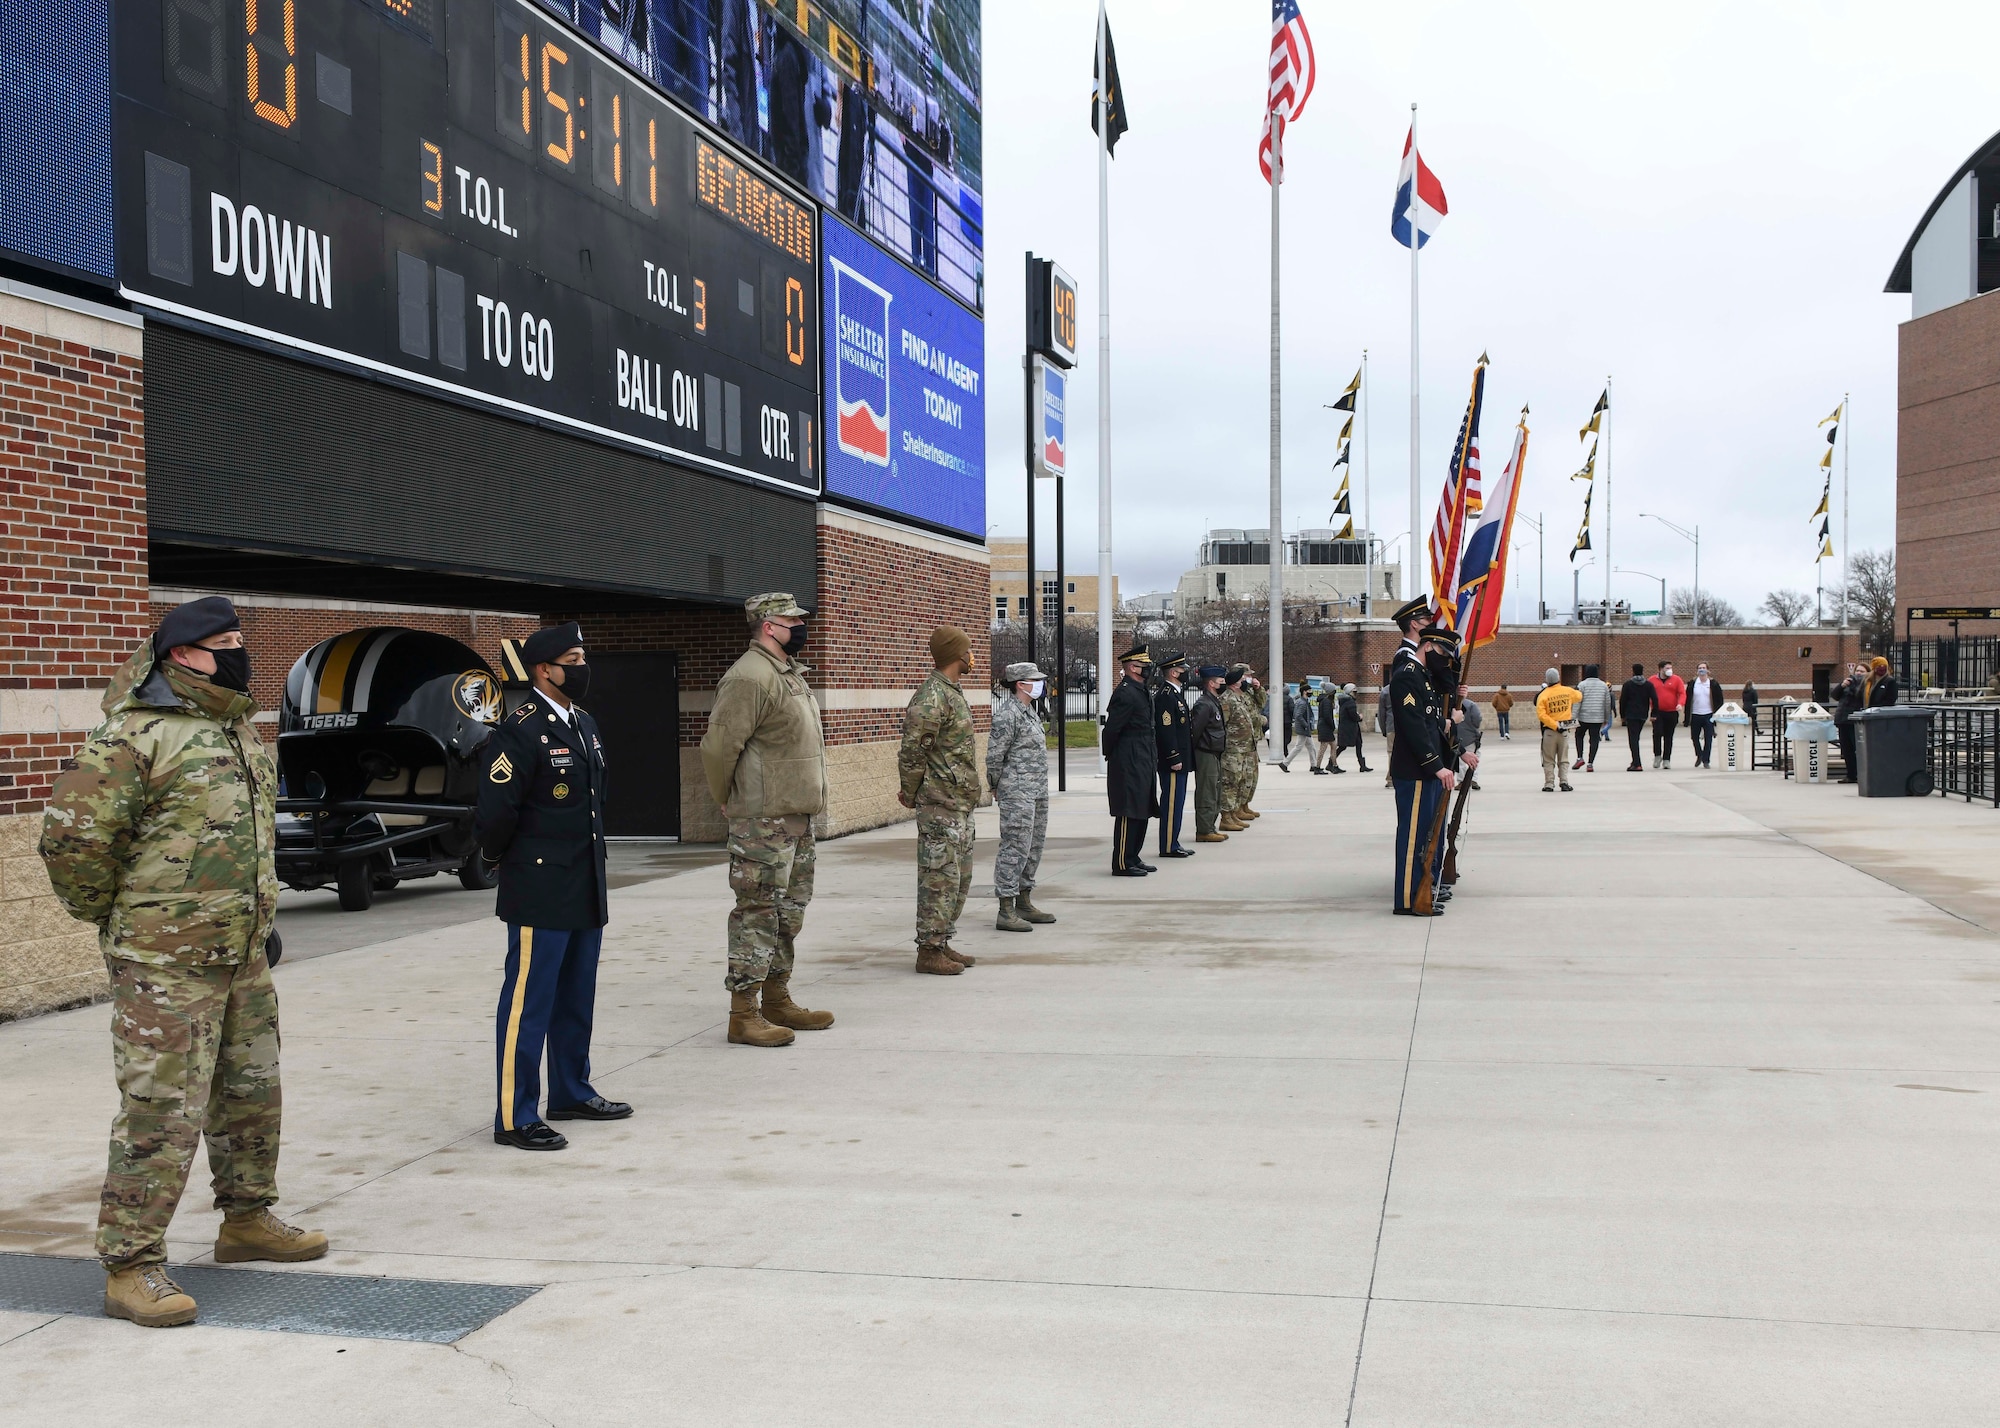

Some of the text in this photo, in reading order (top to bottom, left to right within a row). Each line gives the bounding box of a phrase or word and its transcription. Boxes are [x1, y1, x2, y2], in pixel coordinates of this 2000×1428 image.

[520, 33, 657, 208] 15:11
[423, 141, 442, 212] 3
[455, 165, 518, 239] T.O.L.
[698, 143, 811, 264] GEORGIA
[211, 191, 333, 310] DOWN
[643, 259, 687, 316] T.O.L.
[694, 278, 706, 331] 3
[1055, 284, 1075, 349] 40
[477, 294, 554, 382] TO GO
[785, 276, 805, 366] 0
[840, 313, 885, 361] SHELTER
[616, 348, 699, 432] BALL ON
[840, 342, 885, 380] INSURANCE
[901, 328, 979, 396] FIND AN AGENT
[760, 404, 795, 463] QTR.
[923, 387, 962, 430] TODAY!
[303, 713, 359, 730] TIGERS
[1548, 699, 1570, 708] EVENT
[1549, 705, 1569, 713] STAFF
[1727, 733, 1736, 767] RECYCLE
[1809, 739, 1818, 778] RECYCLE
